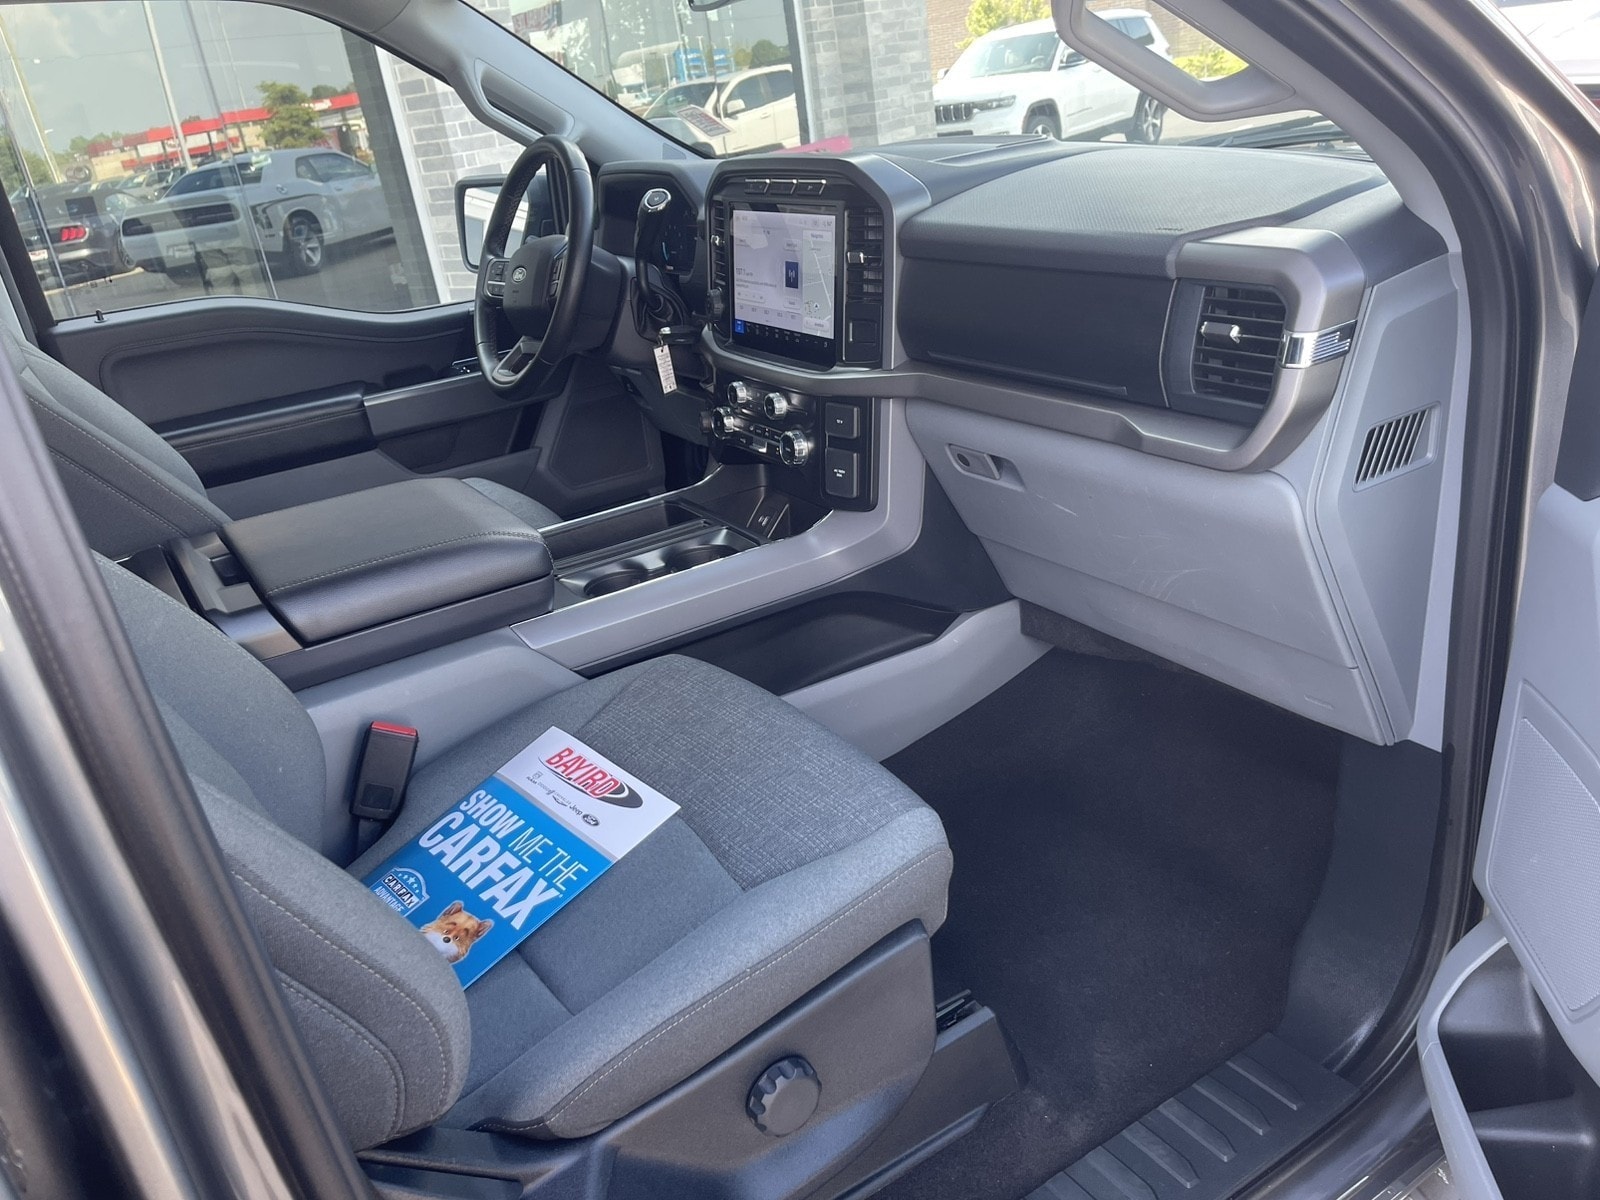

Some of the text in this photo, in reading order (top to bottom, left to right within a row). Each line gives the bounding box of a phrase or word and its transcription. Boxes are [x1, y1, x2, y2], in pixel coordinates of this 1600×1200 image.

[545, 747, 621, 798] BAYIRD
[418, 811, 561, 931] CARFAX
[459, 789, 589, 891] SHOW ME THE
[384, 875, 417, 907] CARFAX
